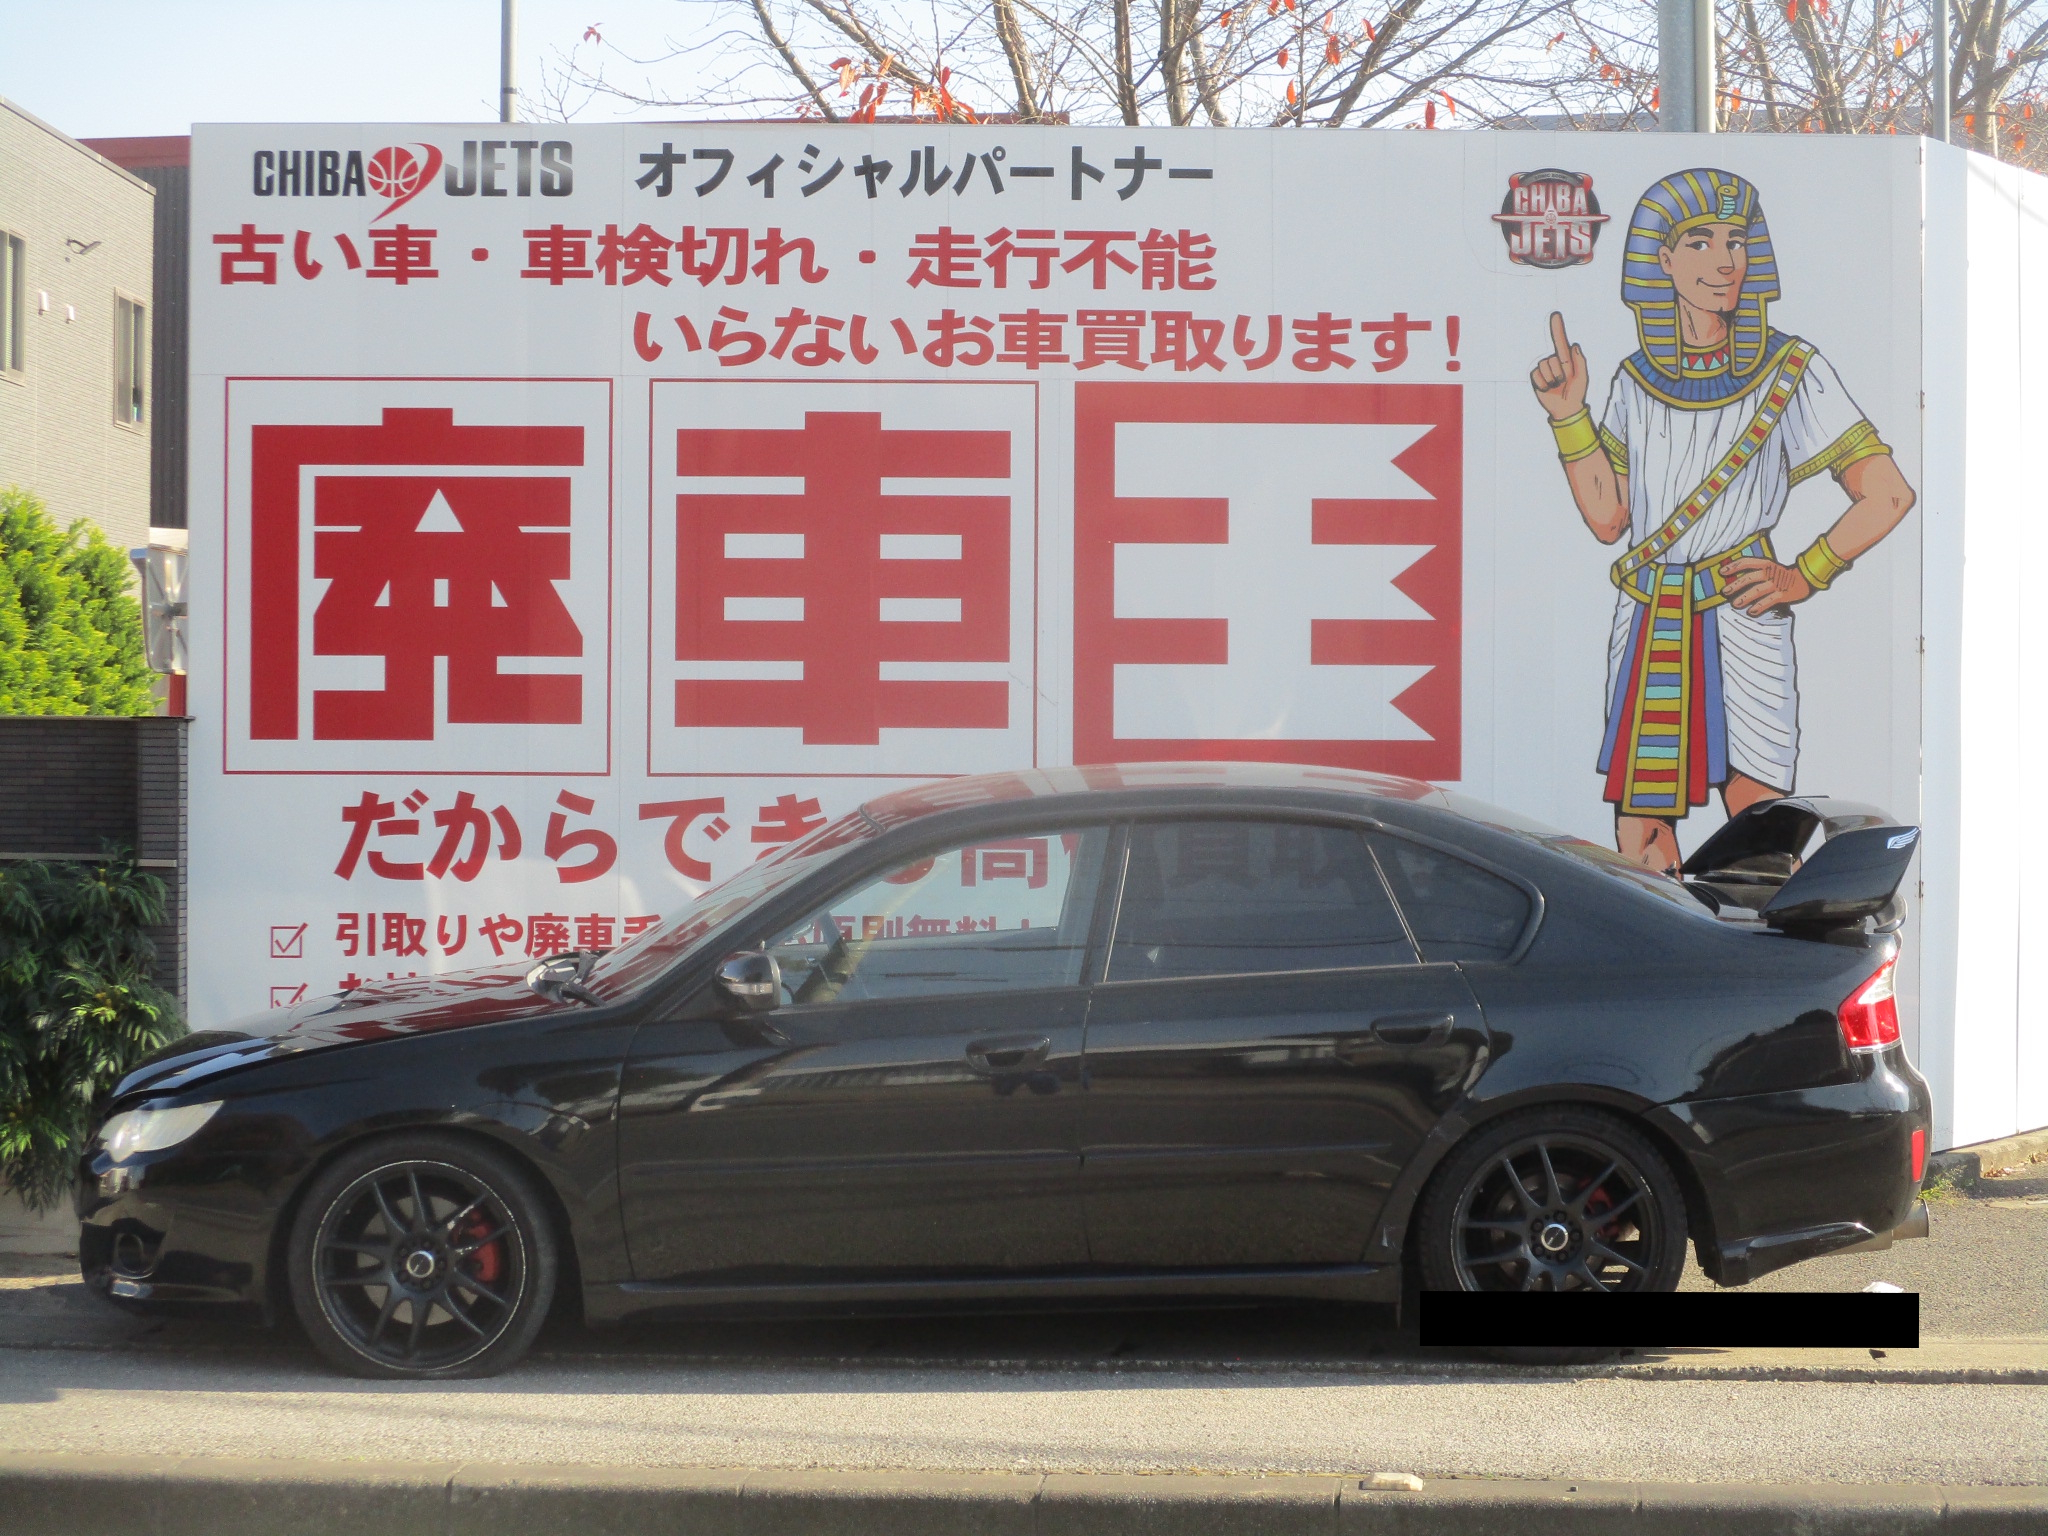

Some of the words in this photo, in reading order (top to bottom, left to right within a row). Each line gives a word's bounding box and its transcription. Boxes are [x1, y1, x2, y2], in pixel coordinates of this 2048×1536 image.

[253, 149, 366, 197] CHIBA
[444, 140, 573, 197] JETS
[636, 141, 1214, 201] オフィシャルパートナー
[1513, 183, 1588, 215] CHIBA
[1510, 221, 1591, 259] JETS
